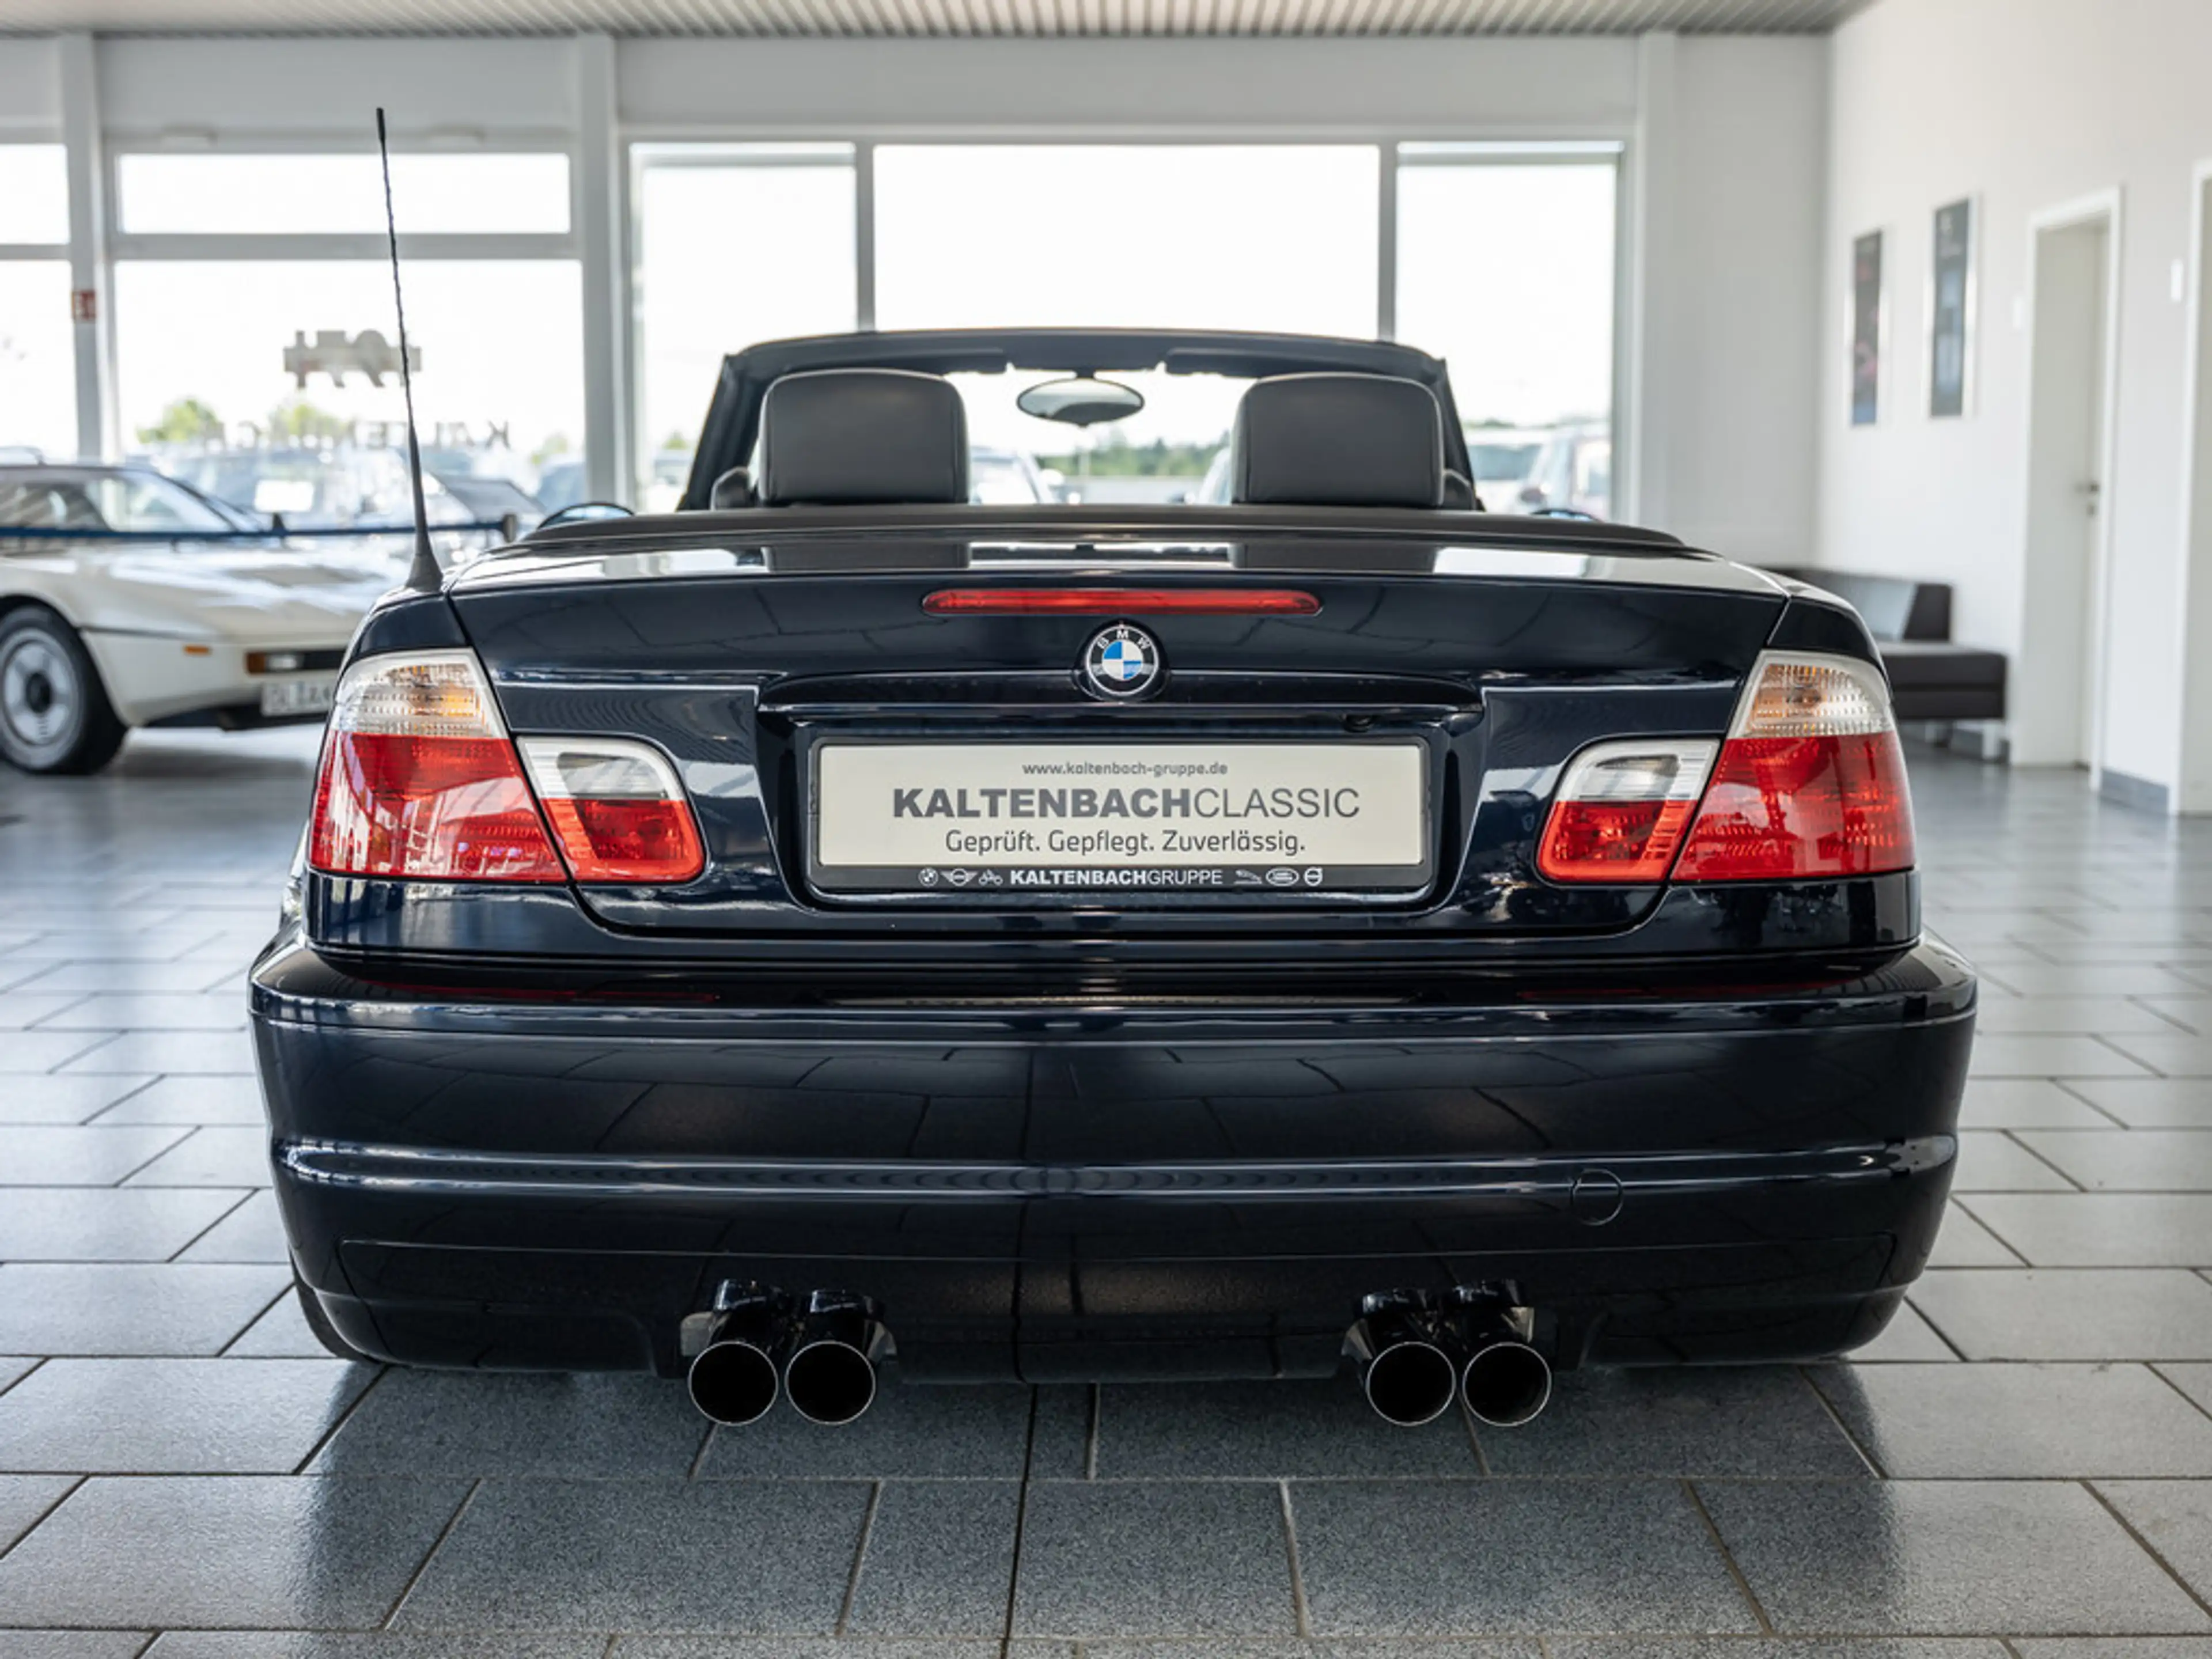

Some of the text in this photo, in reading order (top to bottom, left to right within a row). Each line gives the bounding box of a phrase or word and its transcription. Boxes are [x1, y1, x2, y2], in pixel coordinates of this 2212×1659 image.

[1022, 762, 1228, 777] www.kaltenbach-gruppe.de
[893, 787, 1360, 818] KALTENBACHCLASSIC
[945, 829, 1306, 857] Geprüft. Gepflegt. Zuverlässig.
[1010, 869, 1223, 885] KALTENBACHGRUPPE
